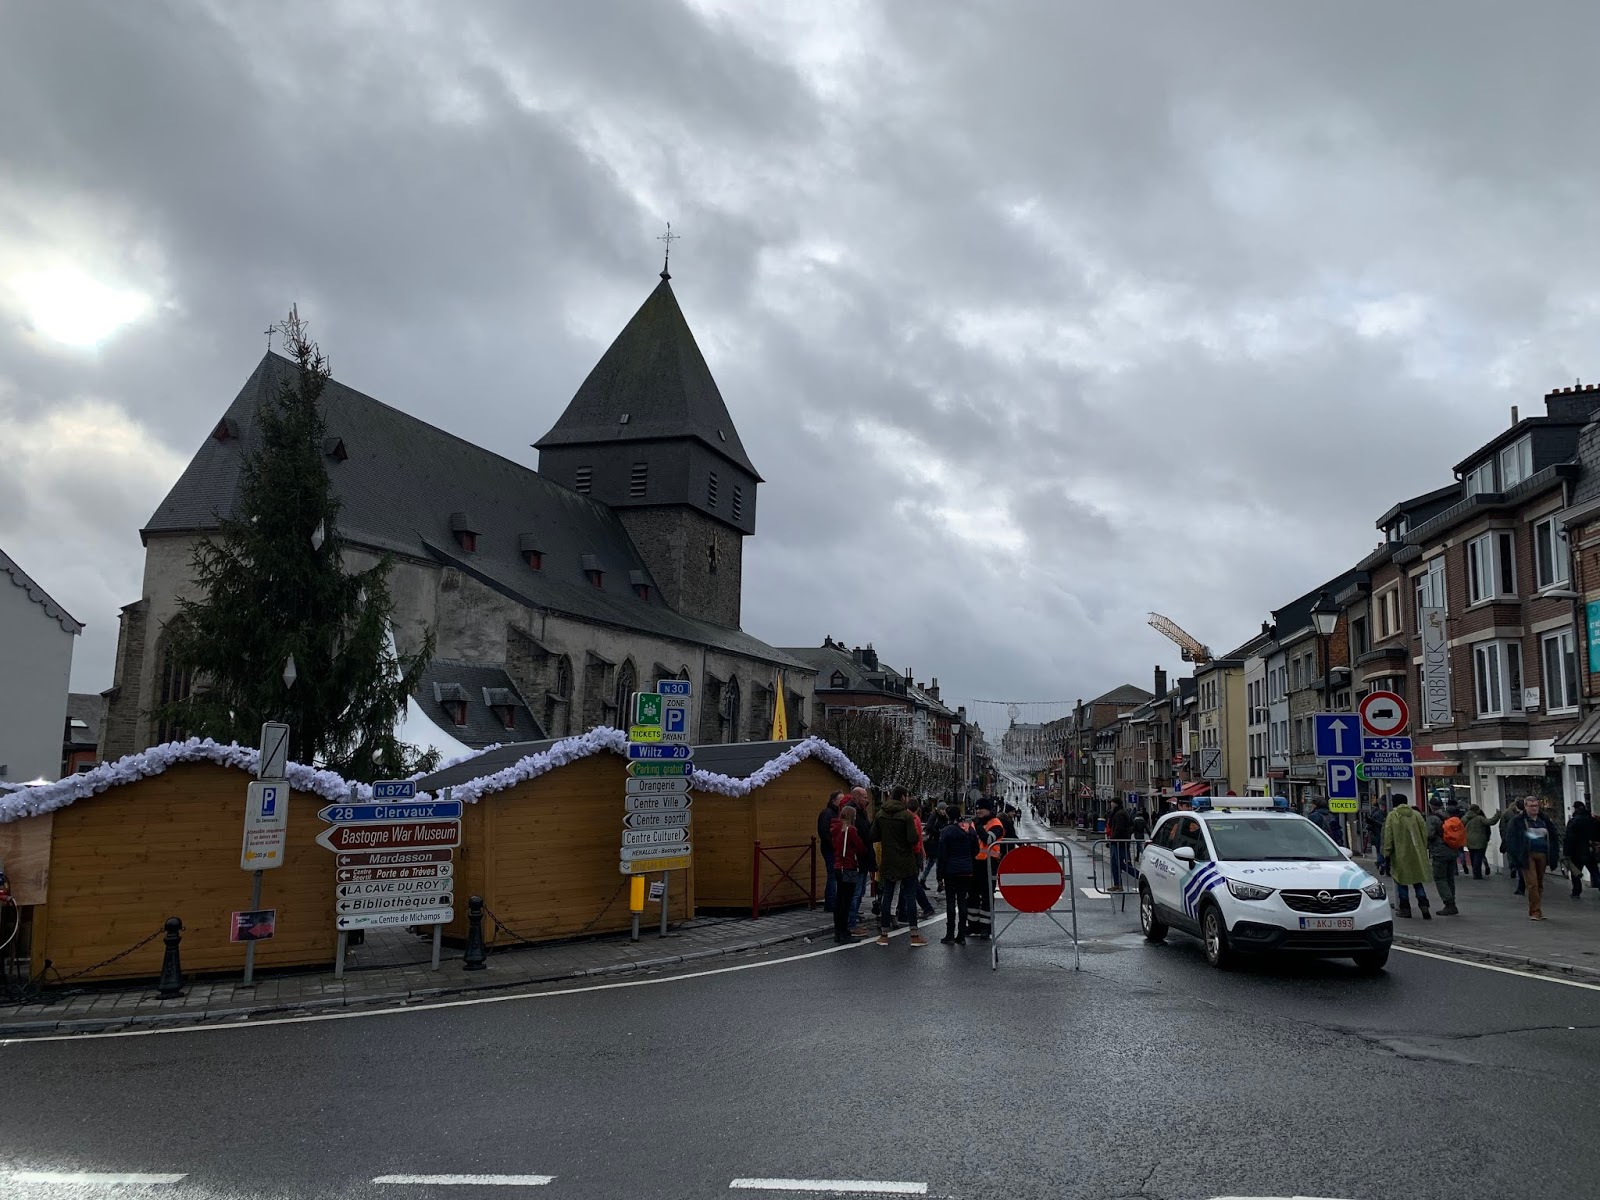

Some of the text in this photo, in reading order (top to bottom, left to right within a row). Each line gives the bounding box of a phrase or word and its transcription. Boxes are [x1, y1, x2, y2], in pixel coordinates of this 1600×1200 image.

[1427, 641, 1448, 720] SLABBINCK
[664, 684, 684, 693] N30
[668, 710, 682, 731] P
[663, 733, 687, 741] PAYANT
[639, 747, 686, 757] Wiltz 20
[636, 763, 660, 776] Parking
[685, 763, 691, 774] P
[1331, 765, 1352, 793] P
[639, 781, 675, 793] Orangerie
[264, 789, 274, 810] P
[634, 797, 679, 809] Centre Ville
[335, 806, 434, 820] 28 Clervaux
[636, 812, 687, 825] Centre sportif
[342, 825, 456, 846] Bastogne War Museum
[626, 830, 681, 844] Centre Culturel
[369, 853, 433, 864] Mardasson
[376, 866, 436, 878] Porte de Trèves
[347, 885, 361, 895] LA
[365, 883, 395, 894] CAVE
[397, 882, 413, 891] DU
[416, 880, 440, 890] ROY
[353, 895, 436, 910] Bibliothèque
[378, 915, 399, 924] Centre
[400, 914, 408, 922] de
[409, 912, 441, 923] Michamps
